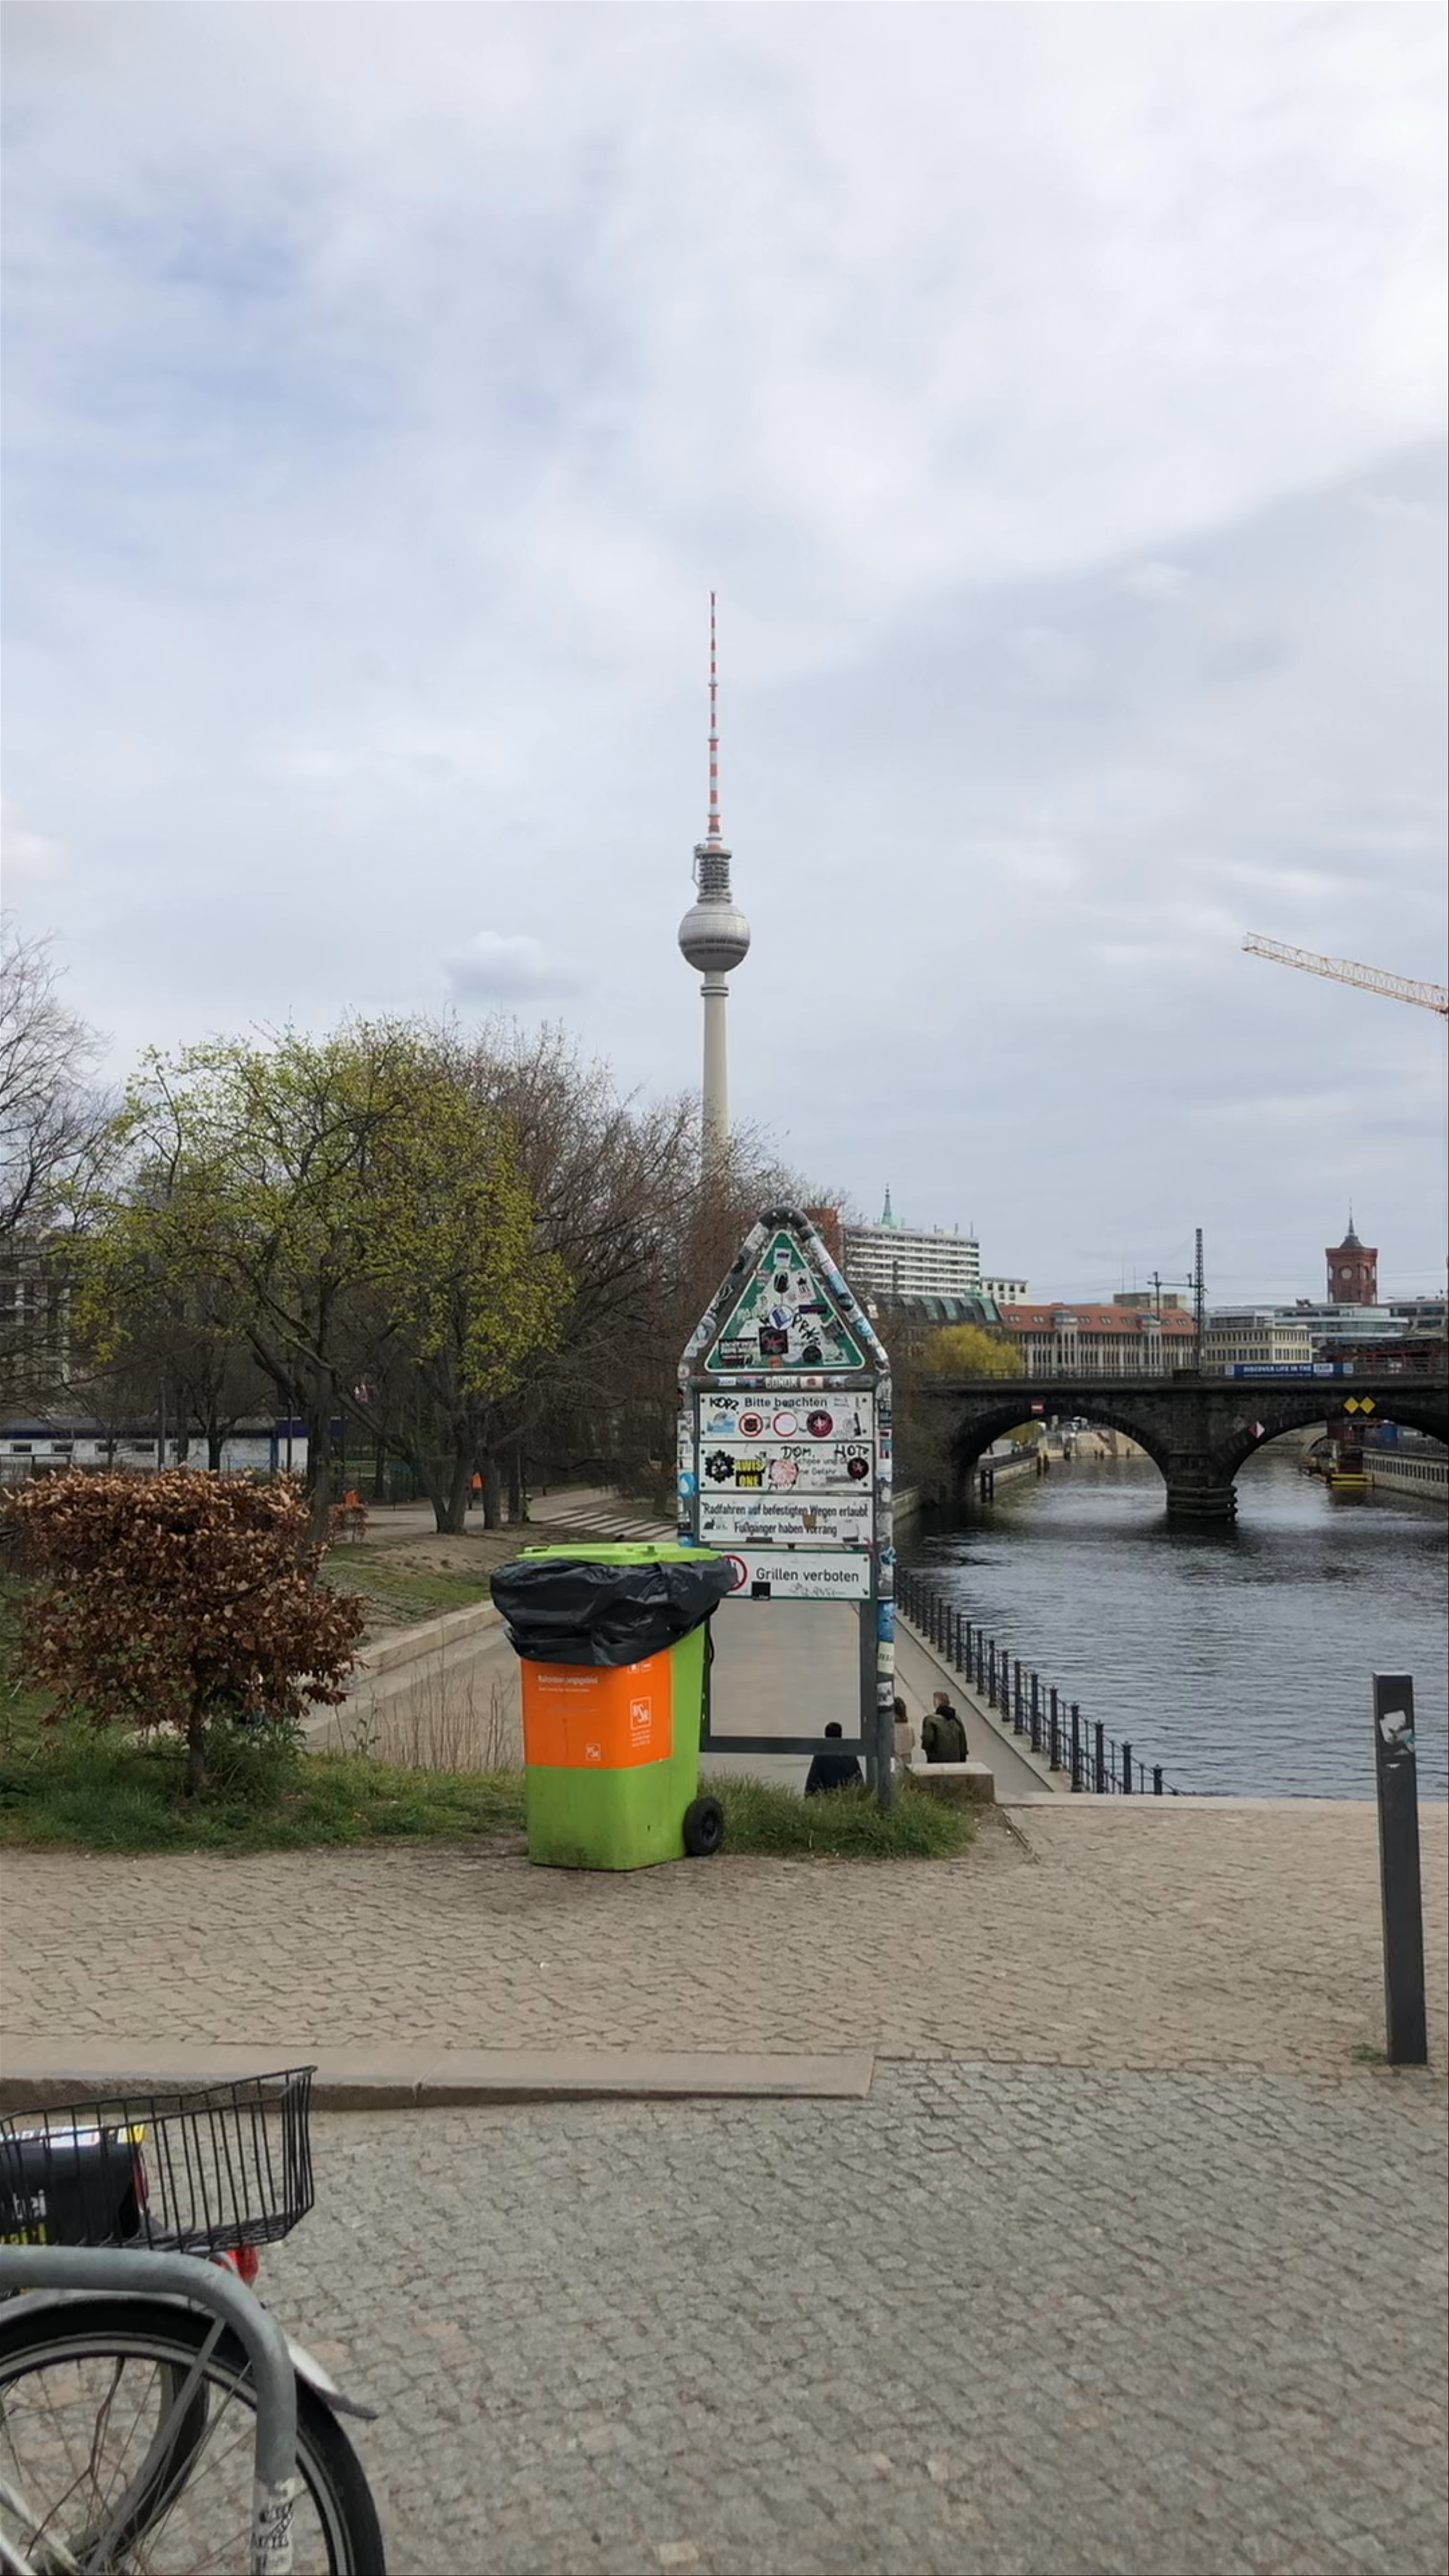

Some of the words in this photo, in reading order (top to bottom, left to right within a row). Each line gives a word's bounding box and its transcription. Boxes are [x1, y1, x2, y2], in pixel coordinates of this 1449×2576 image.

[745, 1397, 771, 1407] Bitte
[775, 1397, 828, 1407] beachten
[738, 1475, 759, 1487] ONE
[703, 1503, 746, 1515] Radfahren
[748, 1504, 761, 1515] auf
[763, 1504, 808, 1518] befestigten
[810, 1505, 837, 1518] Wegen
[839, 1505, 868, 1517] erlaubt
[734, 1522, 776, 1536] Fußgänger
[778, 1523, 803, 1534] haben
[756, 1567, 798, 1581] Grillen
[803, 1569, 859, 1582] verboten
